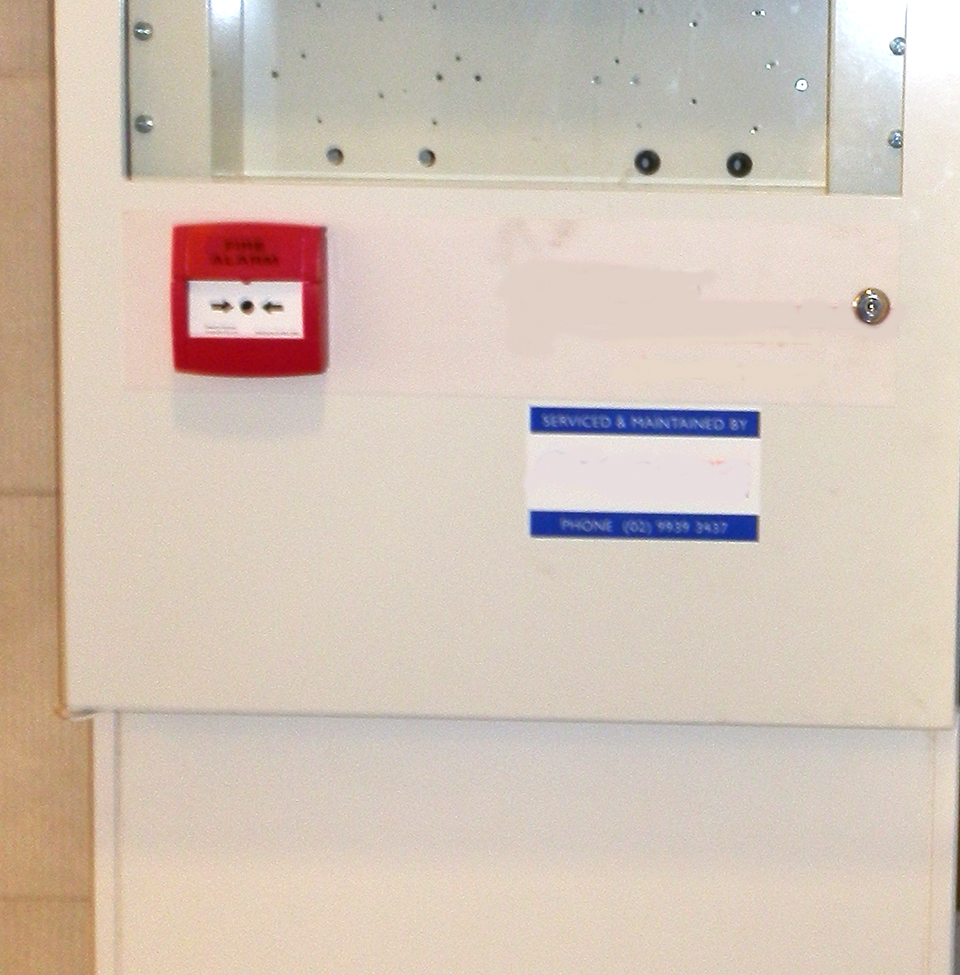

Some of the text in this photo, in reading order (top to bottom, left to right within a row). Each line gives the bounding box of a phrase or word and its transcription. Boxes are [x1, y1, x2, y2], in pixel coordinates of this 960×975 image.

[541, 413, 749, 431] SERVICED & MAINTAINED BY
[560, 518, 613, 533] PHONE
[621, 518, 652, 535] (02)
[656, 520, 690, 534] 9939
